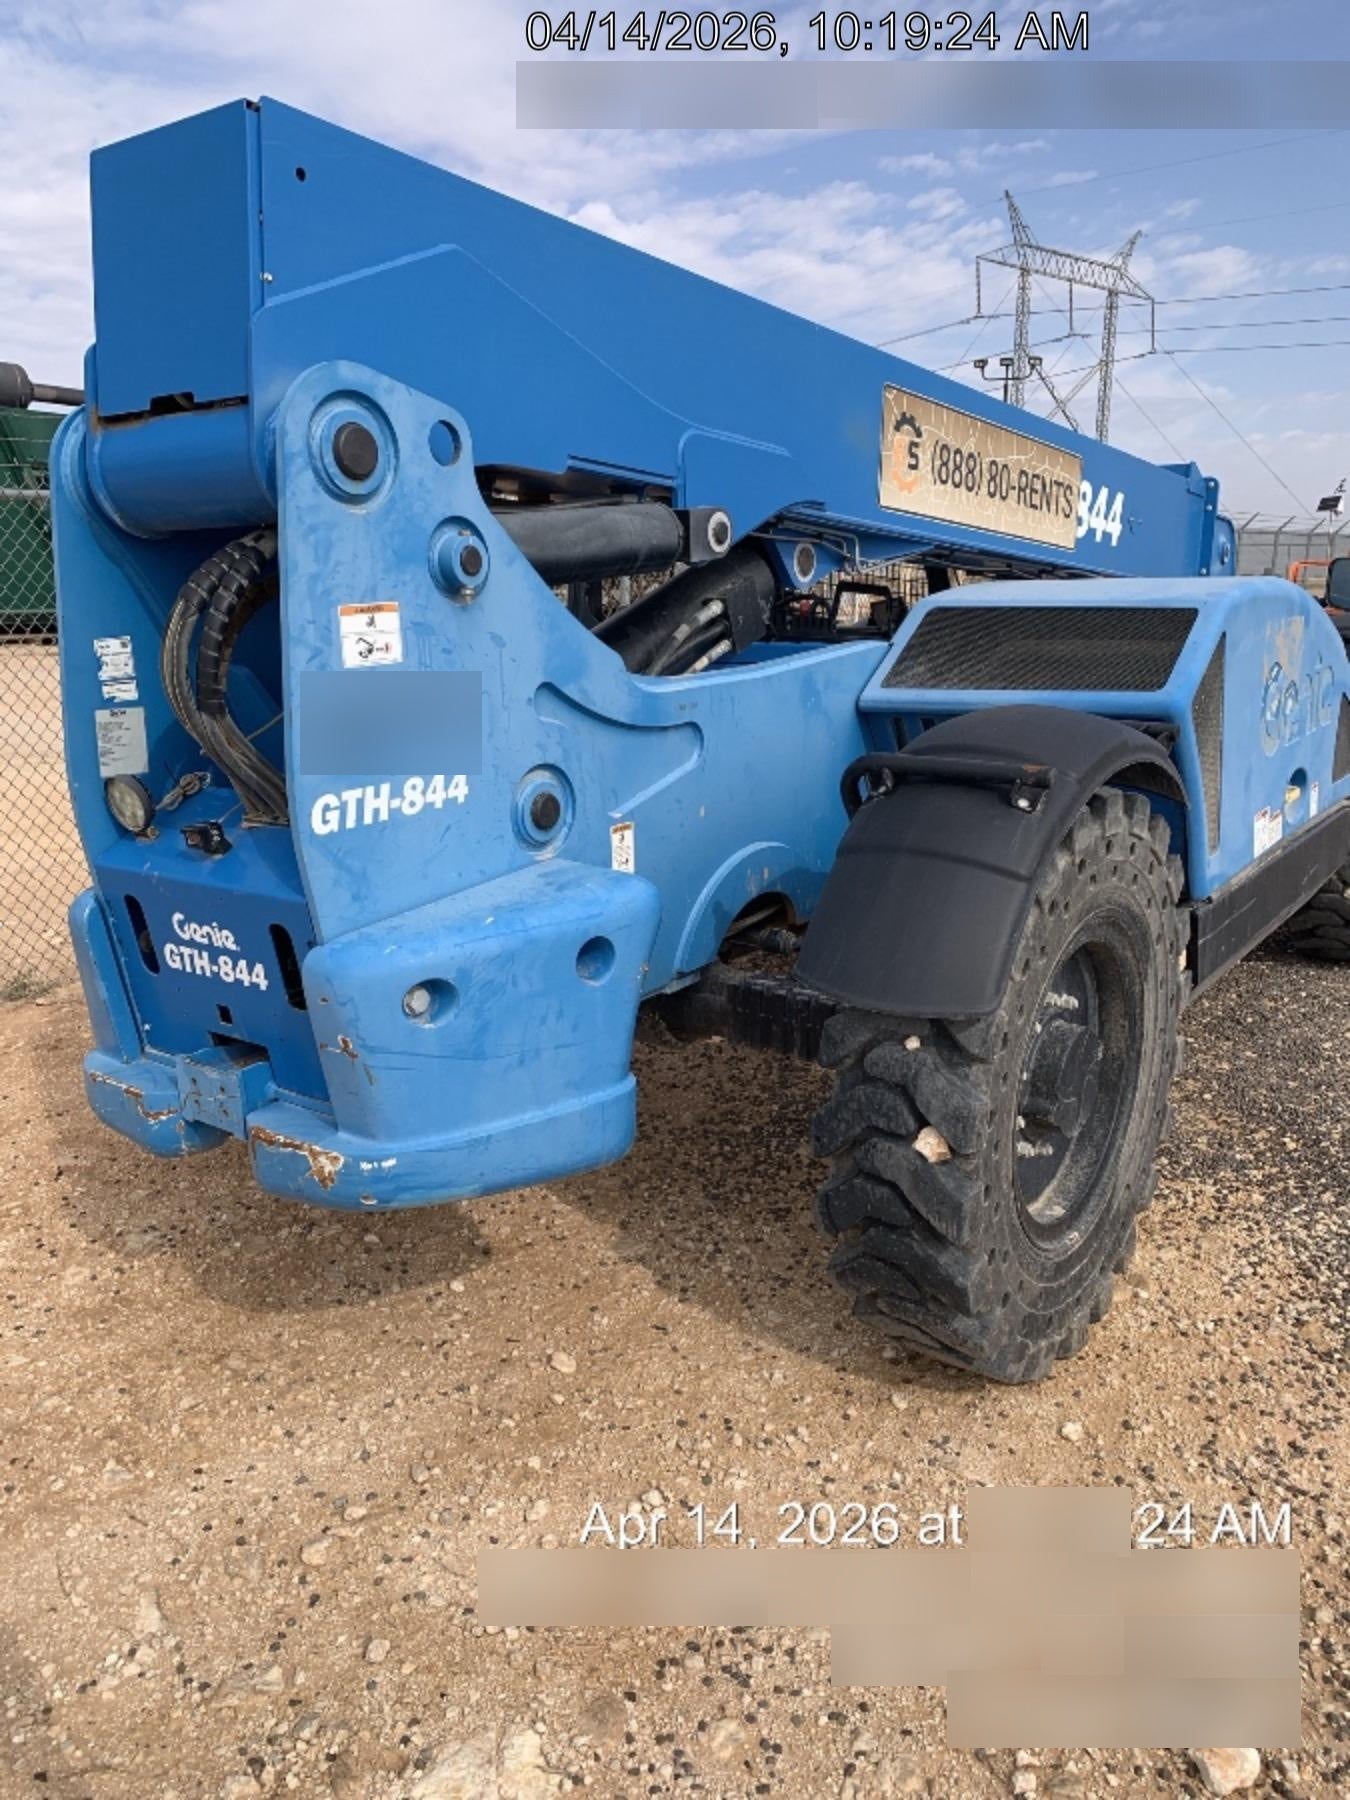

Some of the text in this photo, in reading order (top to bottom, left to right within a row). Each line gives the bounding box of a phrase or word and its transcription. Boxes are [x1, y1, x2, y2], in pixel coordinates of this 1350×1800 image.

[931, 439, 1074, 519] (888) 80-RENTS
[310, 774, 469, 836] GTH-844
[171, 911, 241, 952] Genie
[163, 941, 269, 991] GTH-844
